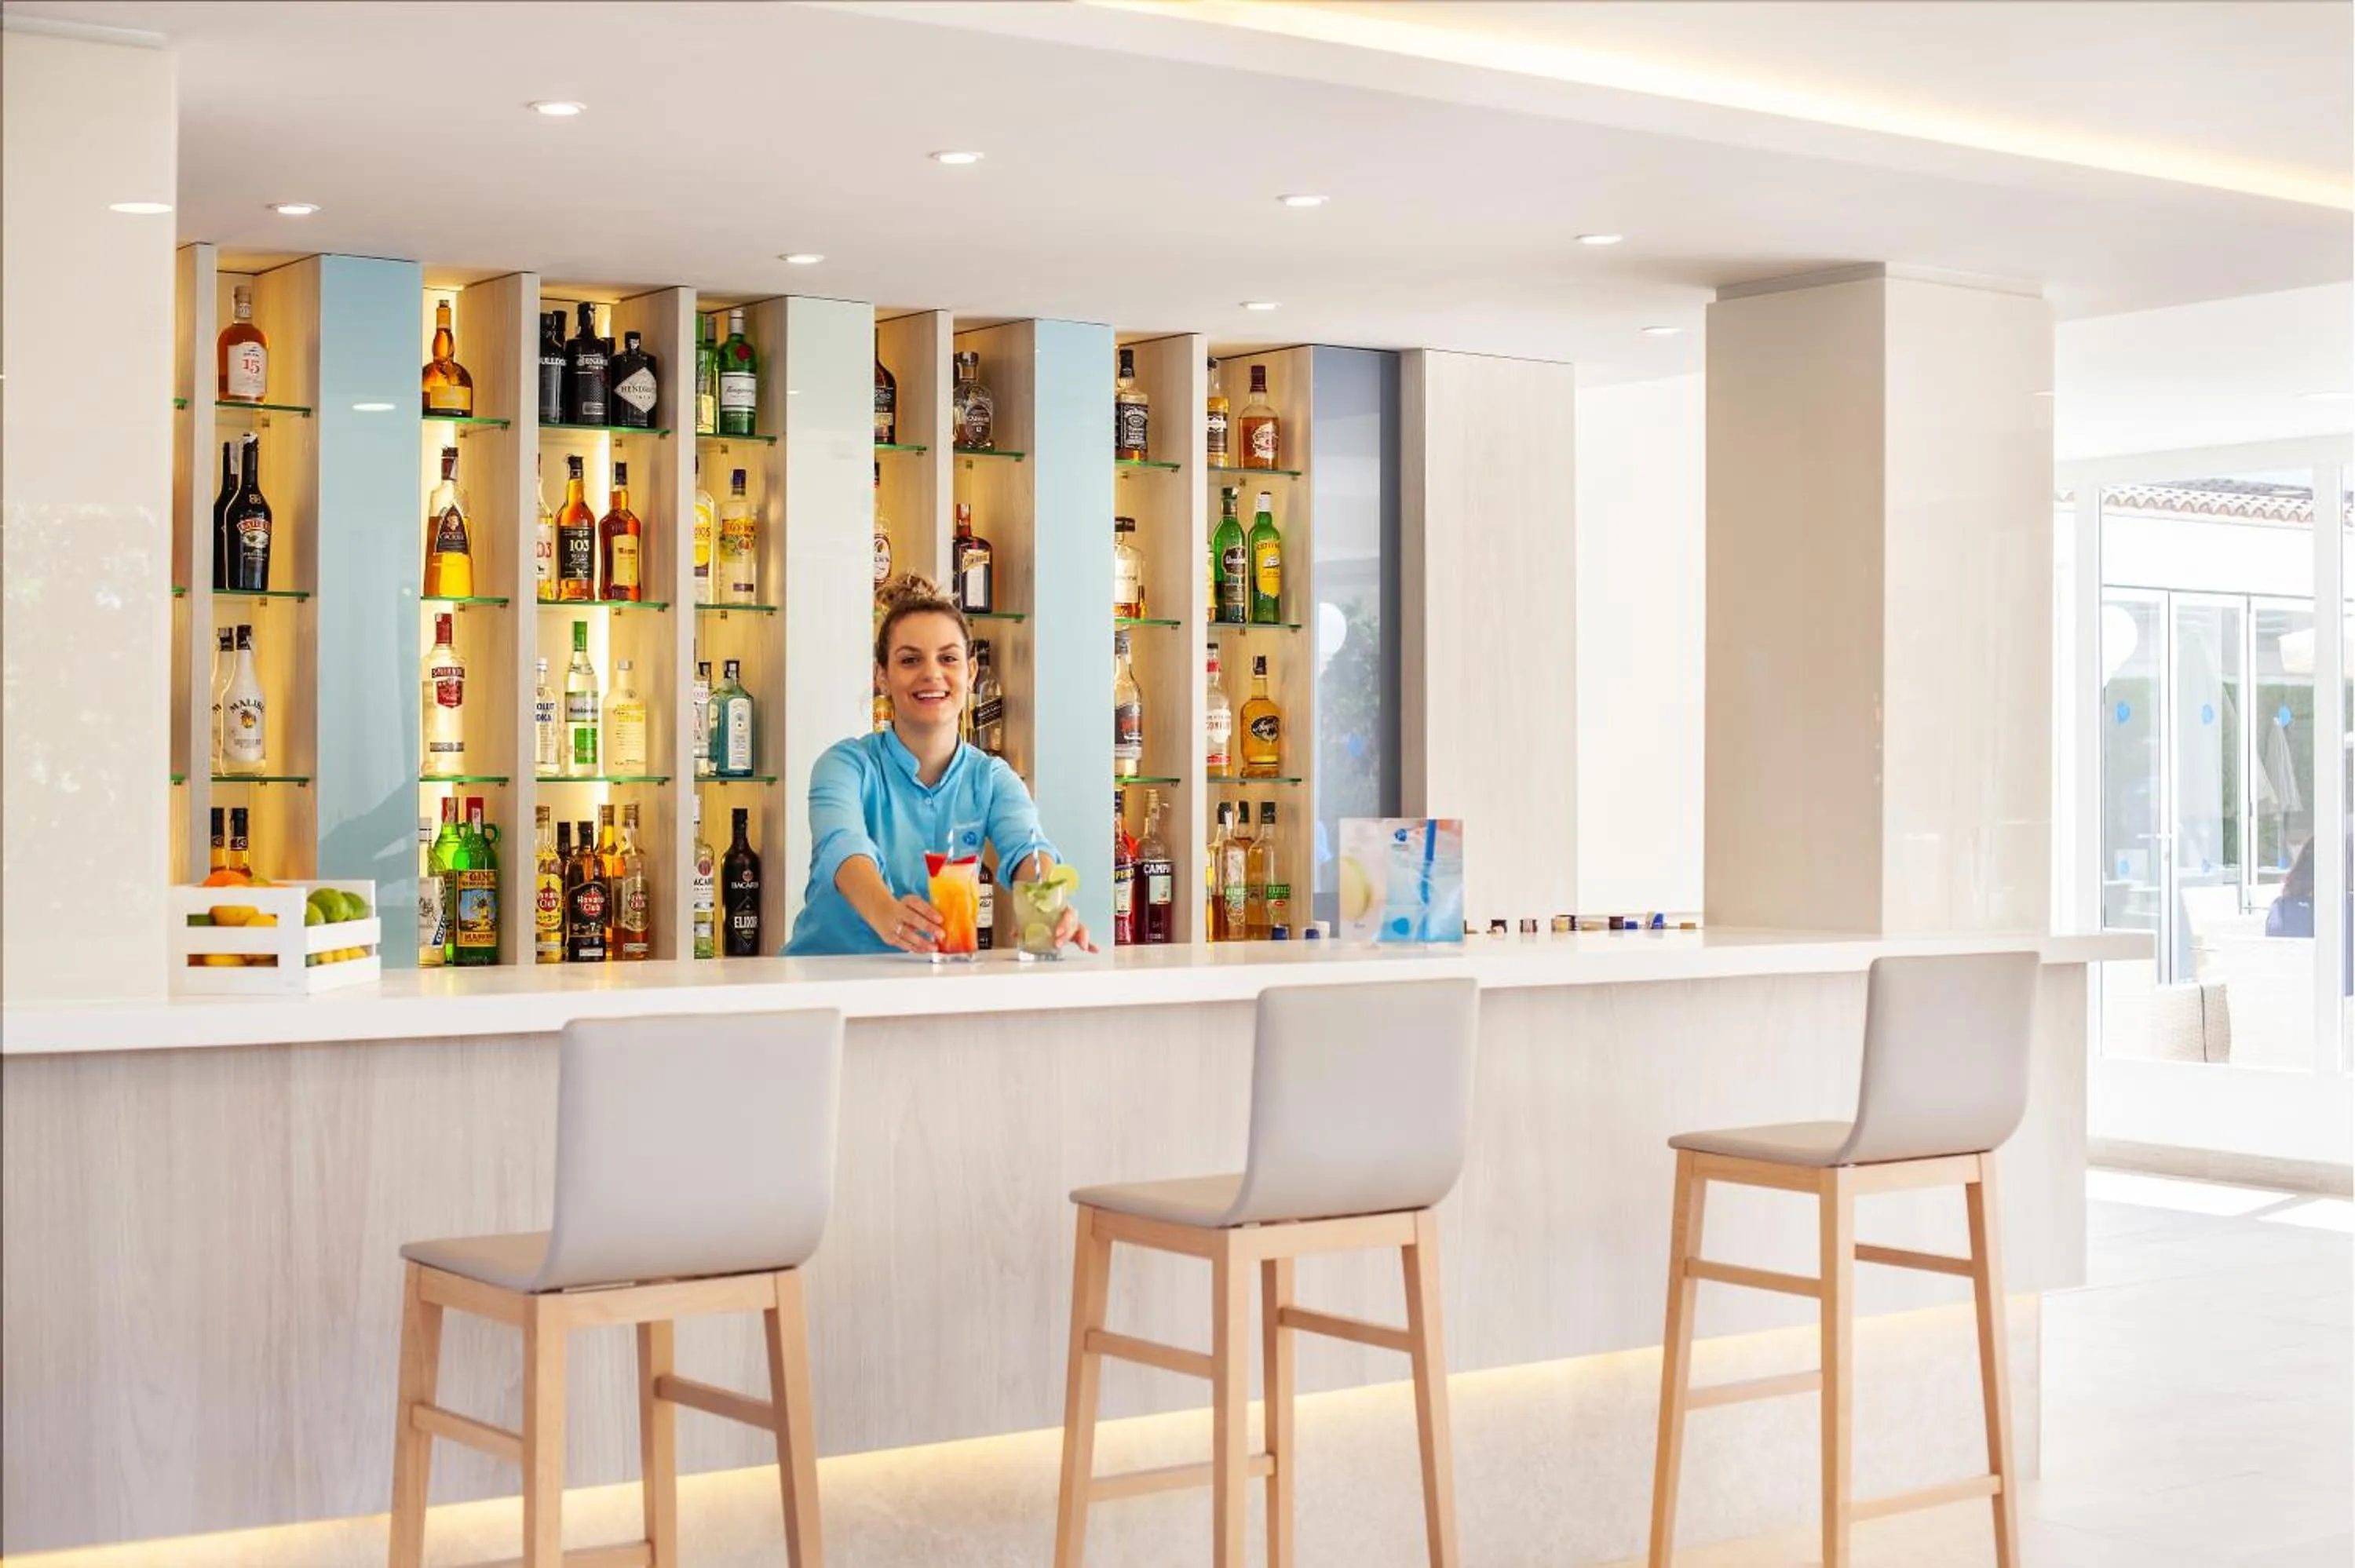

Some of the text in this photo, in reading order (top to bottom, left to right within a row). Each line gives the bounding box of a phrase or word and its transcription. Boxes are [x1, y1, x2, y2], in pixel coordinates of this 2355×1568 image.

[243, 359, 260, 374] 15
[536, 541, 552, 558] 03
[569, 539, 590, 552] 103
[535, 713, 552, 722] DKA
[1144, 864, 1171, 873] CAMPA
[694, 877, 714, 886] ACAR
[590, 922, 597, 932] 7
